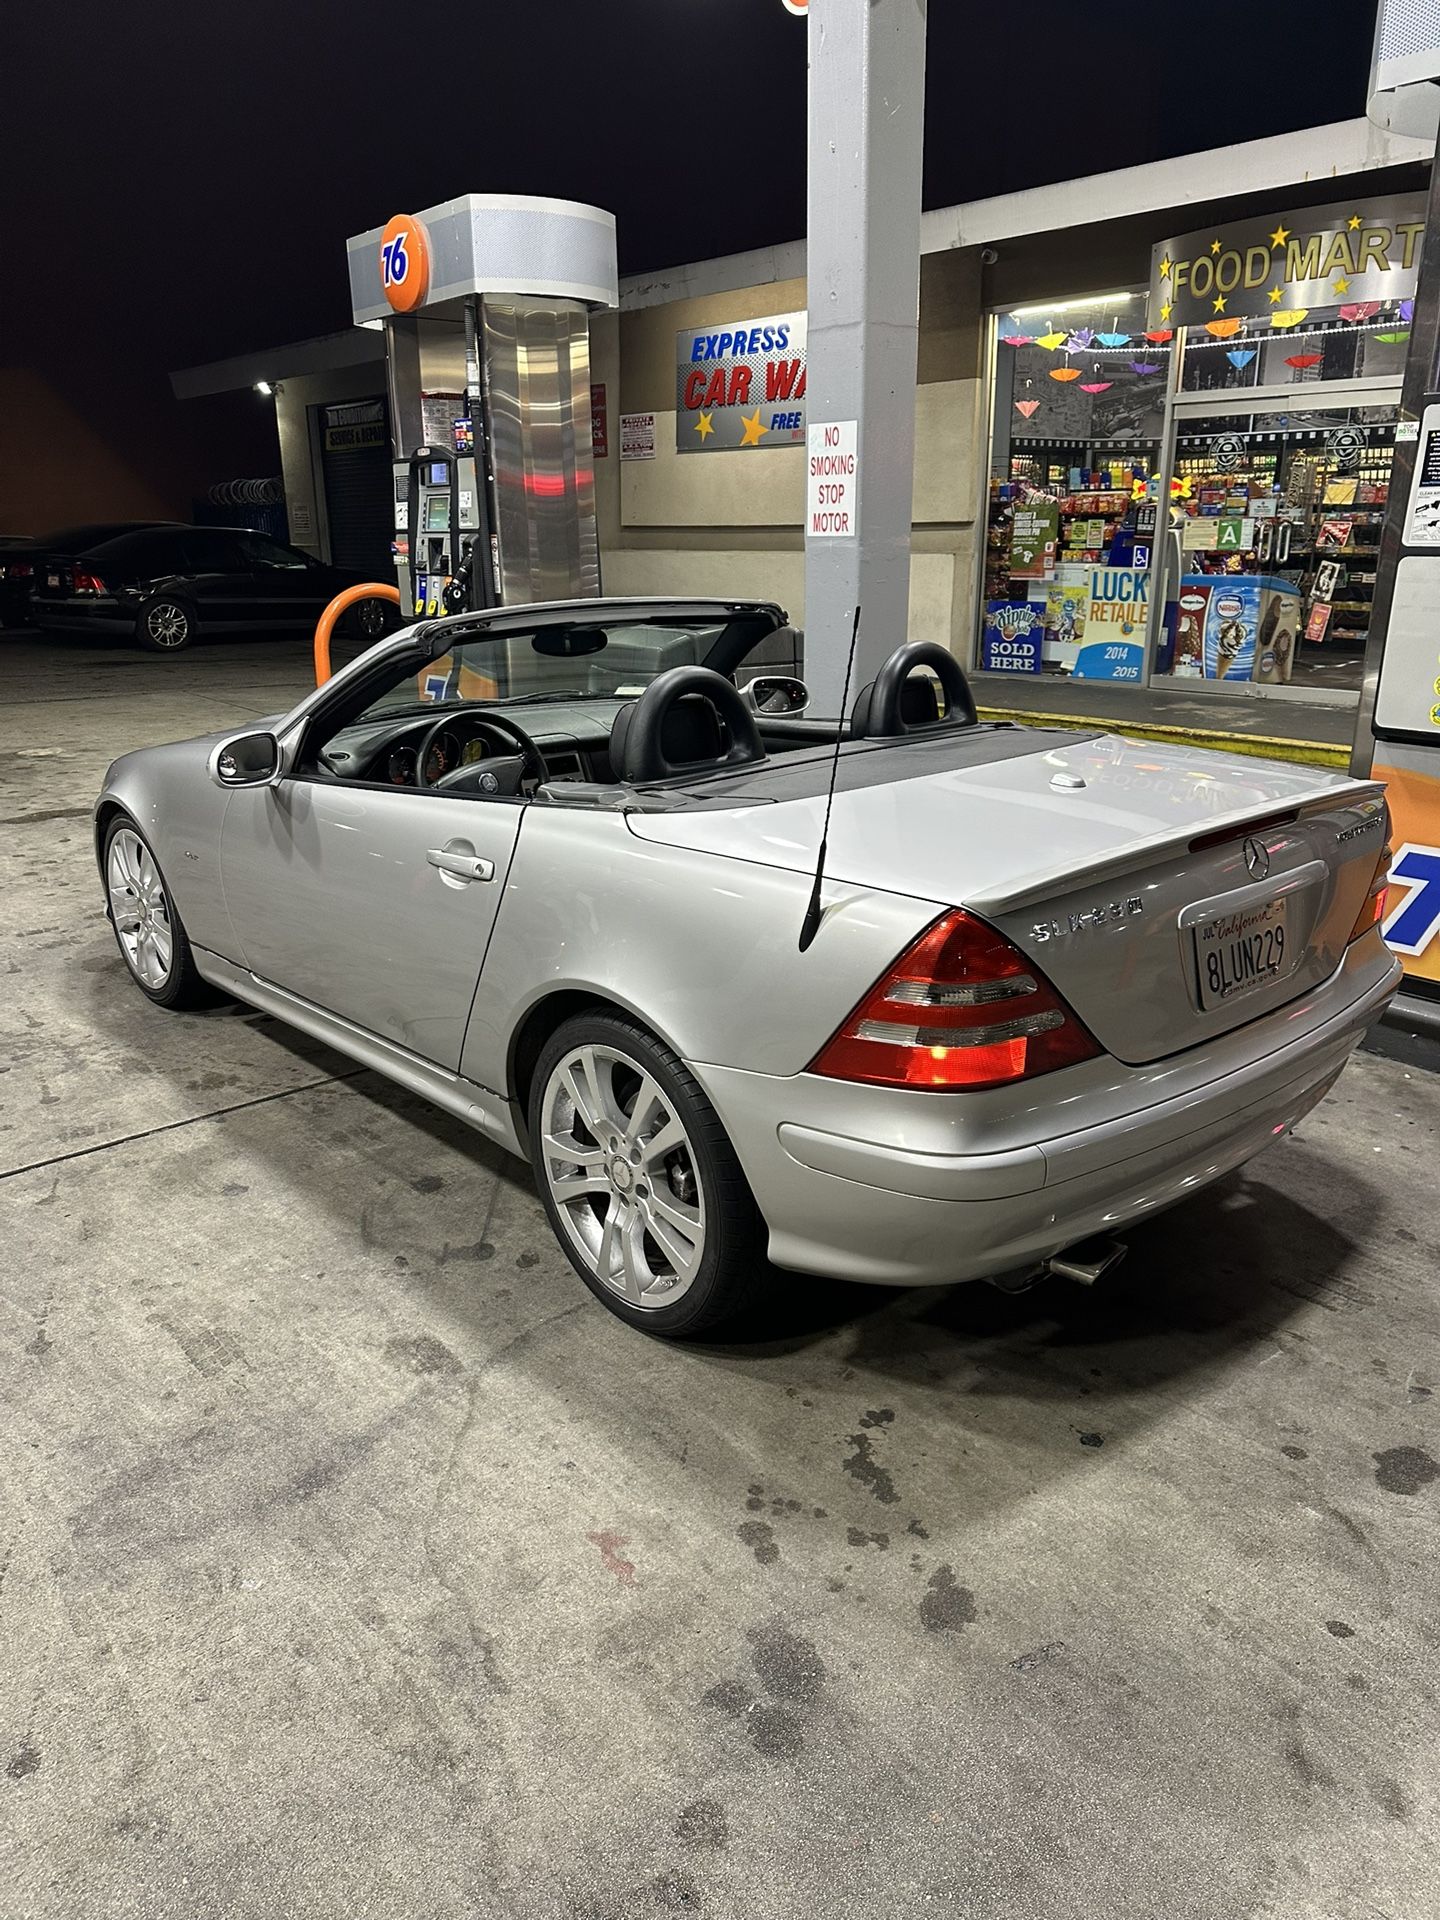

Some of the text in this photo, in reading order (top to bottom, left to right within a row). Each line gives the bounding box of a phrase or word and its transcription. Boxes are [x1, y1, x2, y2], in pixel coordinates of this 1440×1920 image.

[382, 232, 409, 288] 76
[1172, 222, 1425, 304] FOOD MART
[691, 324, 790, 362] EXPRESS
[684, 364, 752, 410] CAR
[771, 411, 802, 430] FREE
[825, 426, 840, 447] NO
[810, 454, 854, 476] SMOKING
[818, 484, 845, 504] STOP
[813, 513, 849, 532] MOTOR
[1221, 525, 1237, 543] A
[1092, 571, 1151, 602] LUCK
[990, 642, 1035, 655] SOLD
[1104, 647, 1129, 660] 2014
[990, 657, 1035, 671] HERE
[1112, 666, 1139, 679] 2015
[1217, 911, 1273, 940] California
[1206, 924, 1285, 993] 8LUN229
